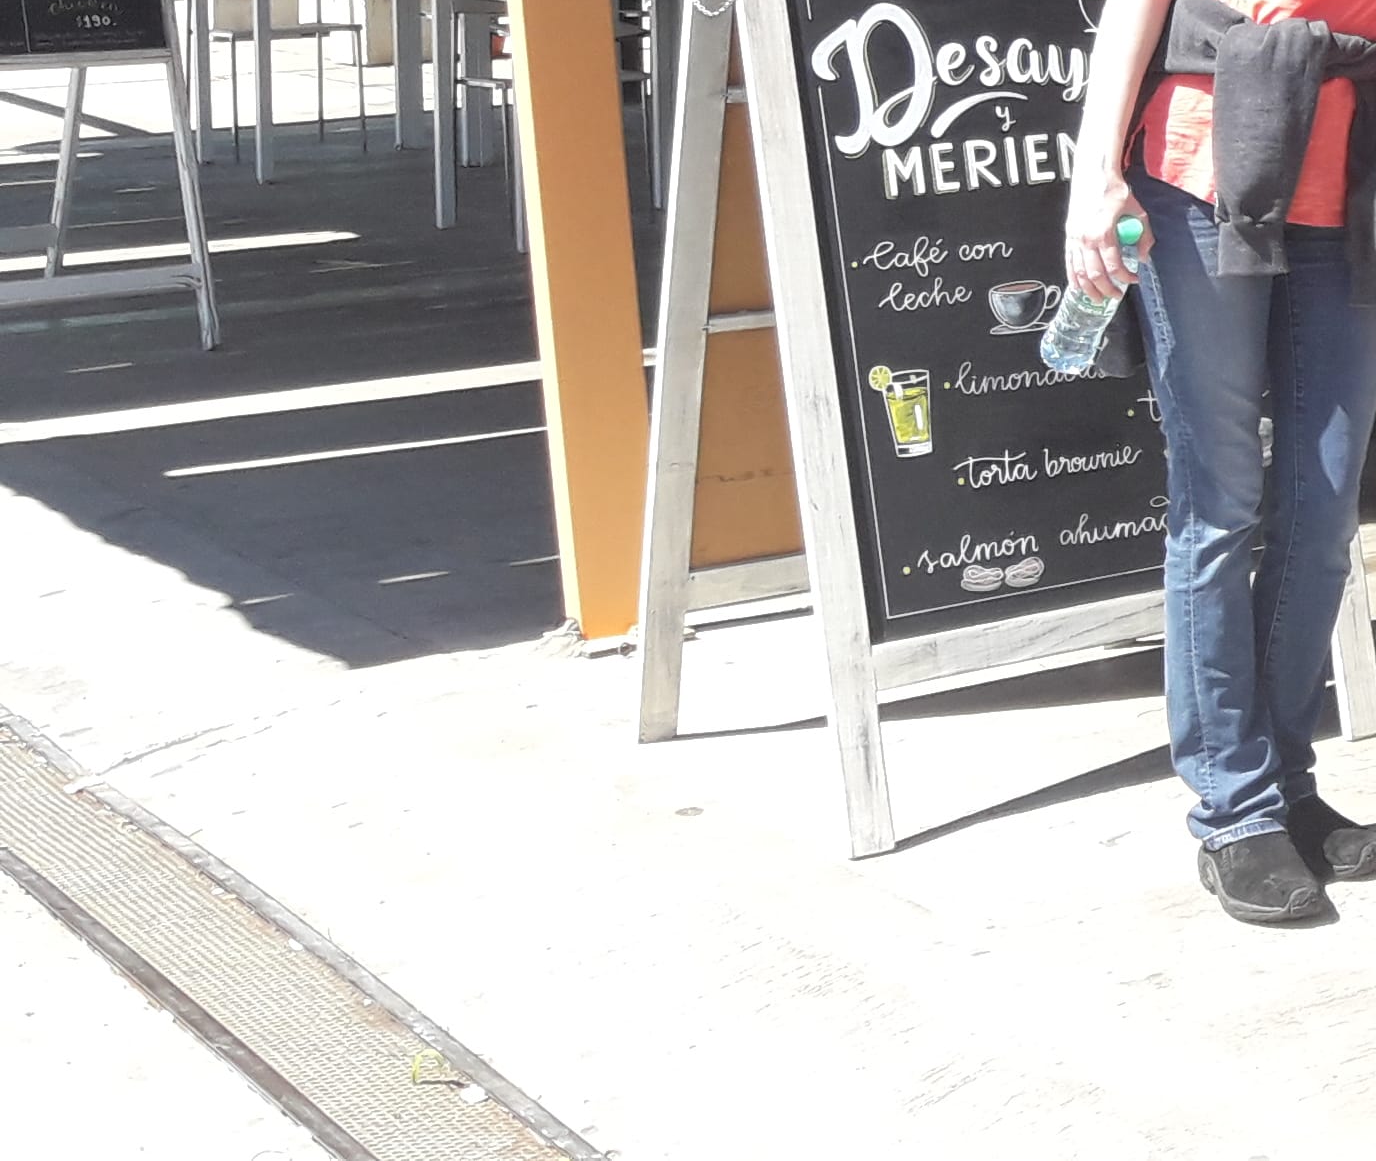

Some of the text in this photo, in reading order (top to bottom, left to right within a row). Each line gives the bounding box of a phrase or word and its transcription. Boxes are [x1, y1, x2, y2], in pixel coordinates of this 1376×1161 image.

[994, 105, 1017, 132] y
[863, 236, 1014, 277] Café con
[878, 276, 973, 312] leche
[953, 445, 1143, 490] torta brownie
[917, 530, 1040, 574] salmón
